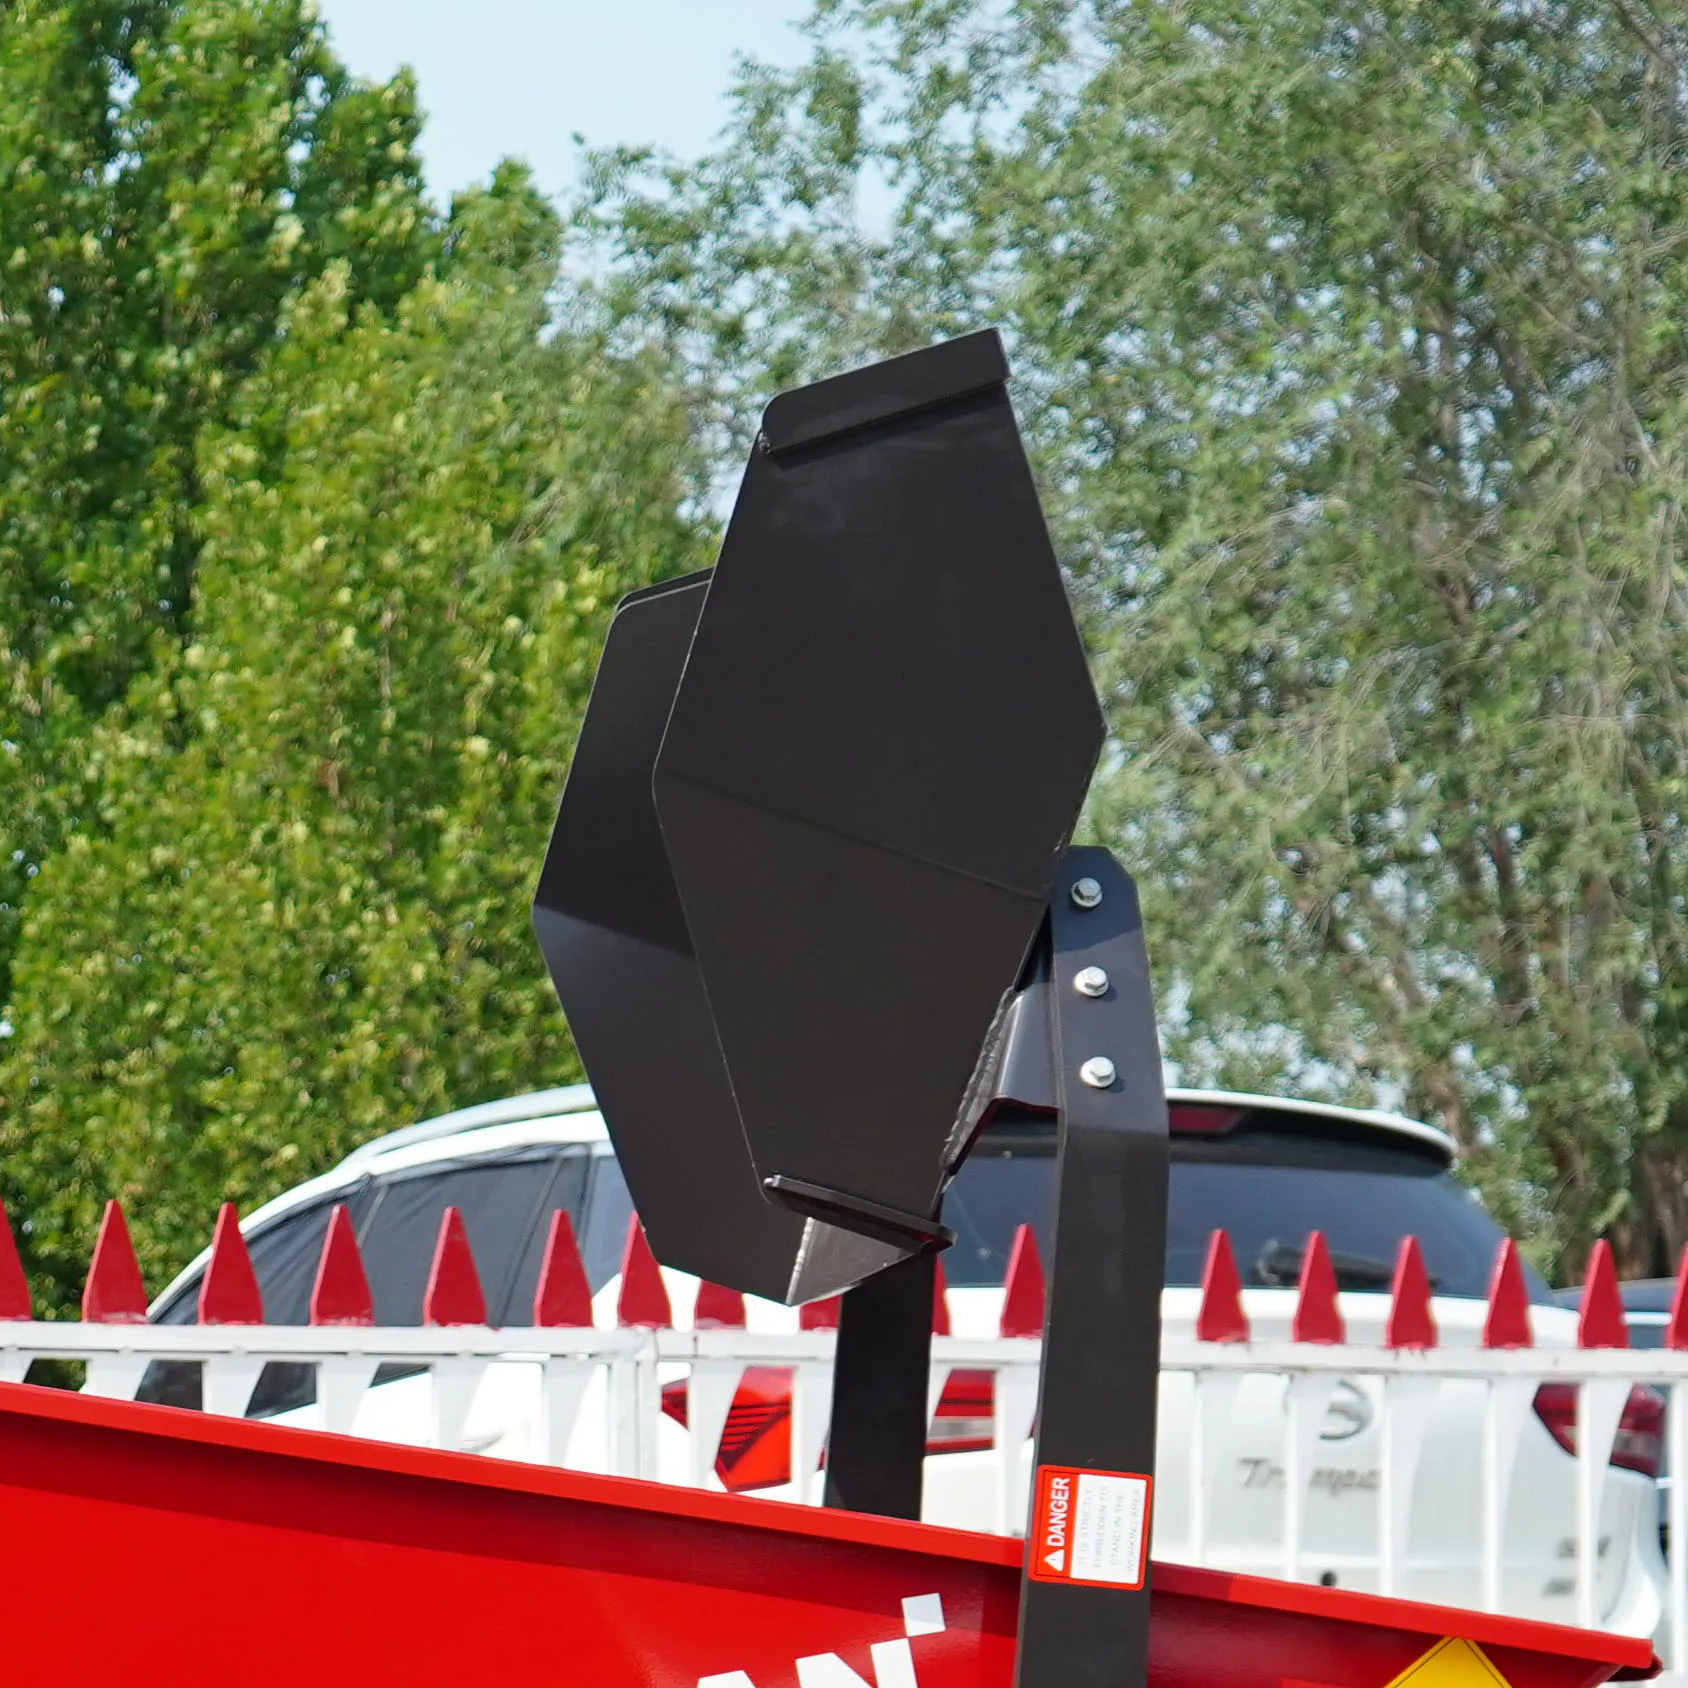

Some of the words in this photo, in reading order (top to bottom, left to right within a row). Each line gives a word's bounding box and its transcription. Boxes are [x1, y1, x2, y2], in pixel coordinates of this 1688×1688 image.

[1047, 1477, 1069, 1546] DANGER
[1092, 1504, 1107, 1568] FORBIDDEN
[1109, 1529, 1121, 1565] STAND
